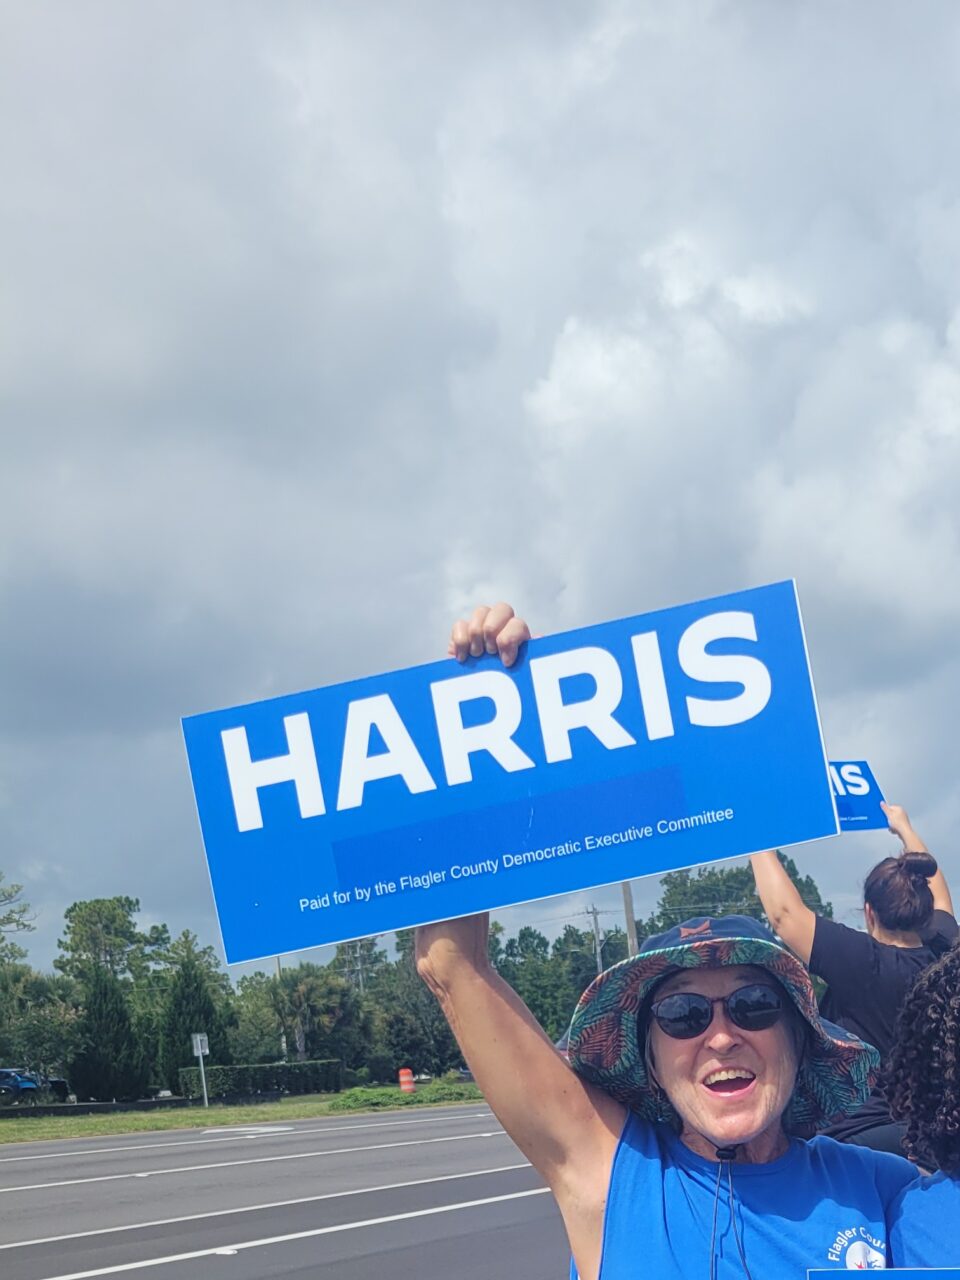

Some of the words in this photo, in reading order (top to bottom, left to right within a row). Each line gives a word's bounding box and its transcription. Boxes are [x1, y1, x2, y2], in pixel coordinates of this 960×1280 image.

[222, 612, 771, 831] HARRIS
[829, 764, 870, 796] IS
[299, 894, 330, 912] Paid
[333, 890, 351, 905] for
[355, 887, 372, 902] by
[374, 881, 397, 896] the
[400, 869, 447, 890] Flagler
[450, 857, 499, 879] County
[502, 840, 581, 868] Democratic
[584, 825, 653, 850] Executive
[656, 808, 734, 834] Committee
[828, 1227, 857, 1262] Flagler
